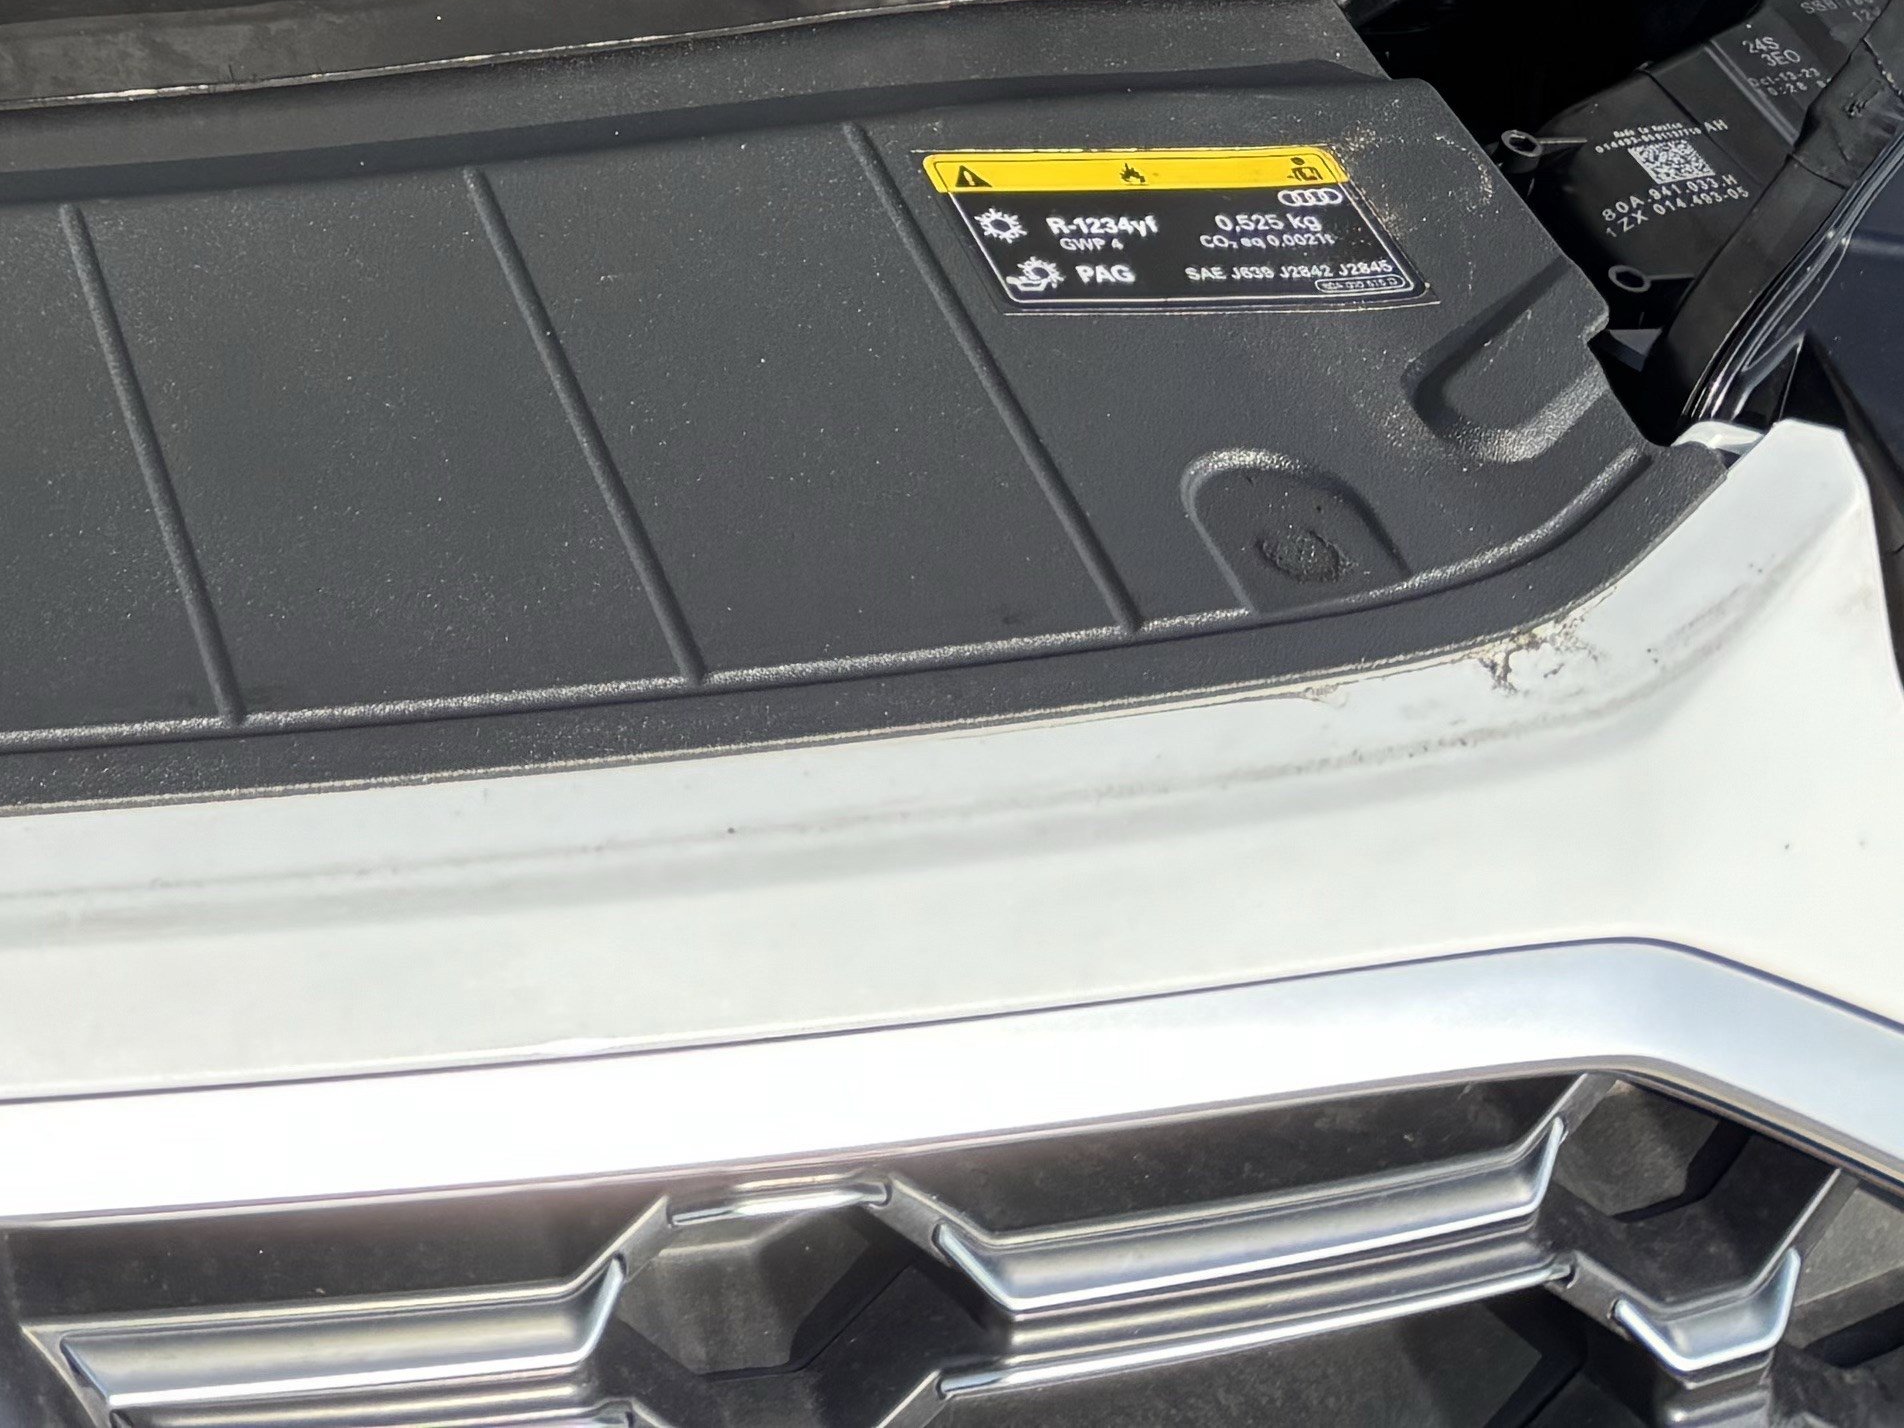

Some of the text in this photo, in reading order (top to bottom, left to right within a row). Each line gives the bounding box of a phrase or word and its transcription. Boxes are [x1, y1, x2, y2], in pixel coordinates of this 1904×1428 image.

[1045, 215, 1158, 237] R-1234yf
[1286, 213, 1322, 232] kg
[1059, 237, 1124, 251] GWP 4
[1075, 264, 1136, 284] PAG
[1185, 259, 1392, 281] SAE J639 J2842 J2845
